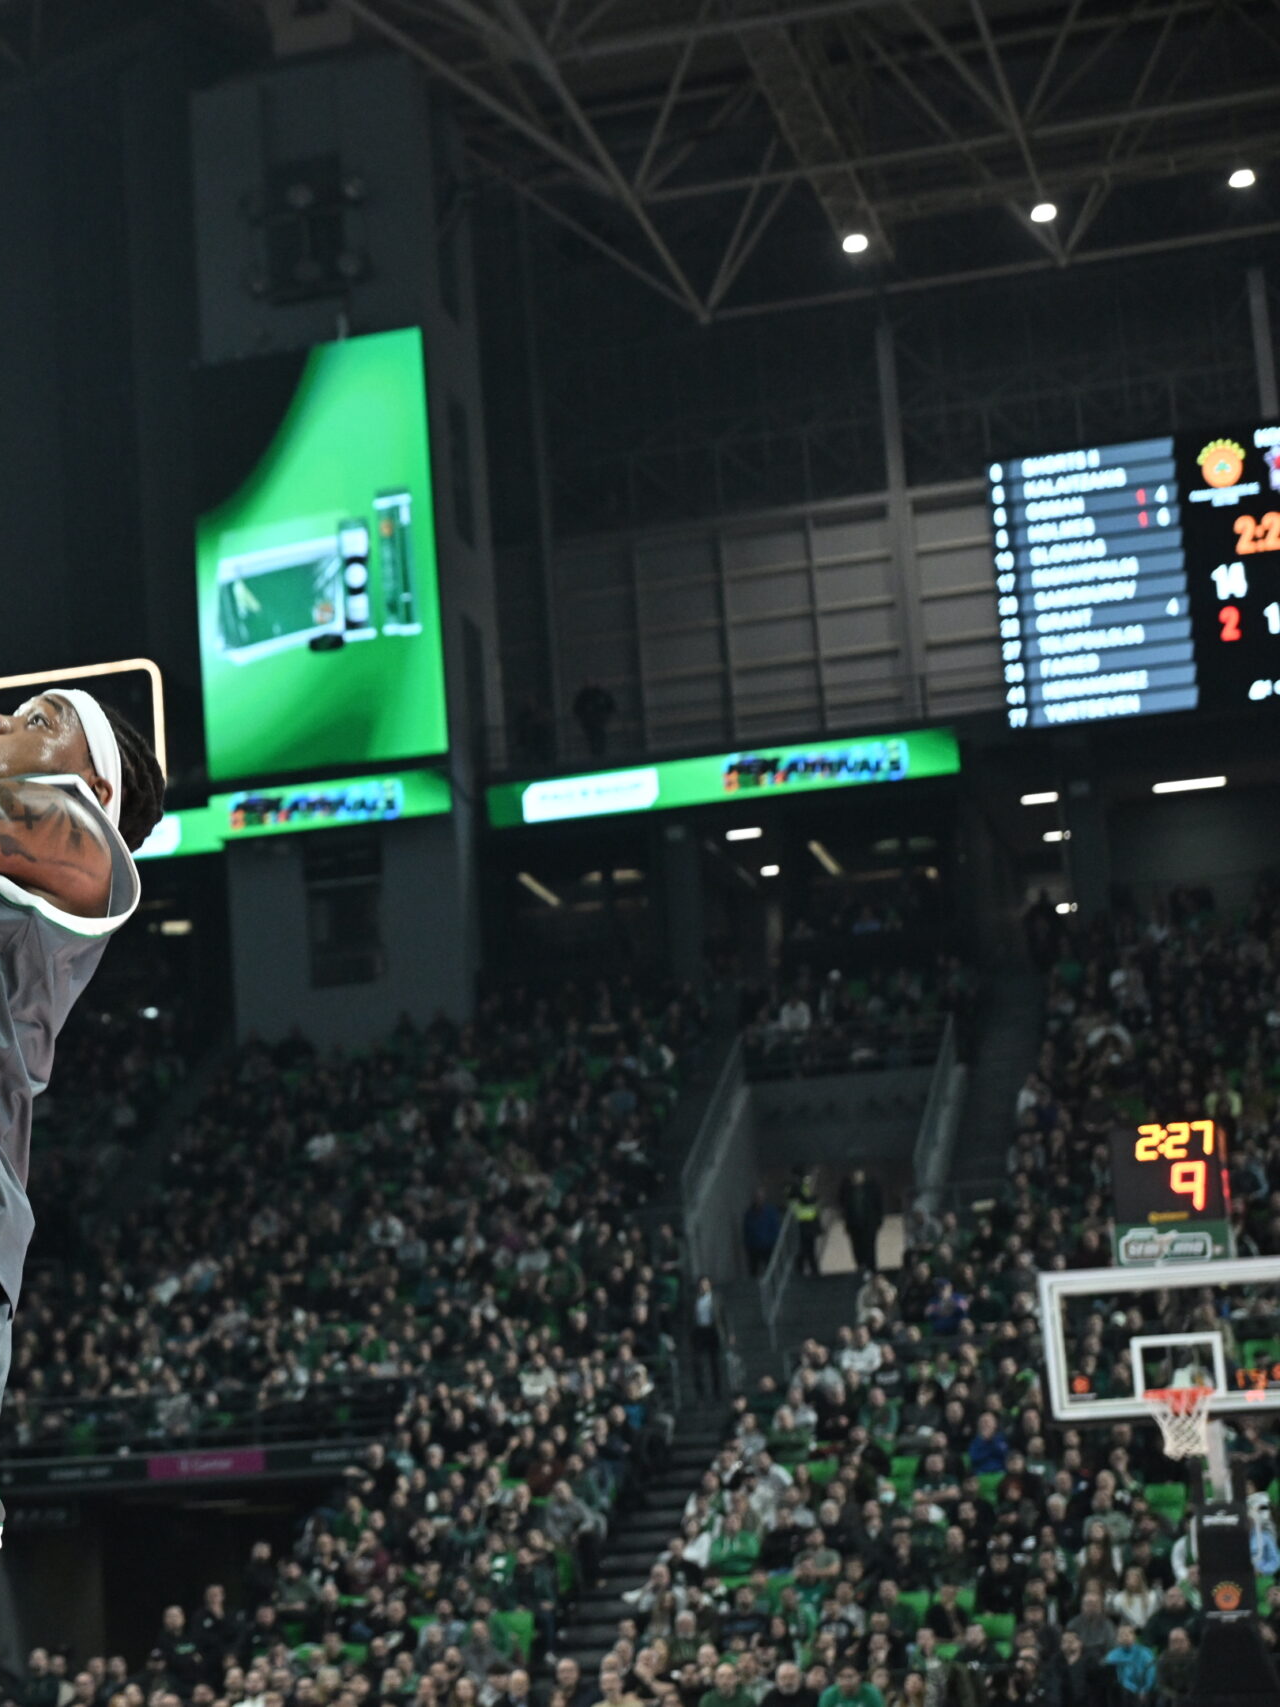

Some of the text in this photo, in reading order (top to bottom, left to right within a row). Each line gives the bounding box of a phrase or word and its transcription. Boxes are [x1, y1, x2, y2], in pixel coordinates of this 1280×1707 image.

[1218, 606, 1242, 642] 2
[1135, 1119, 1214, 1162] 2:27
[1170, 1160, 1206, 1211] 9
